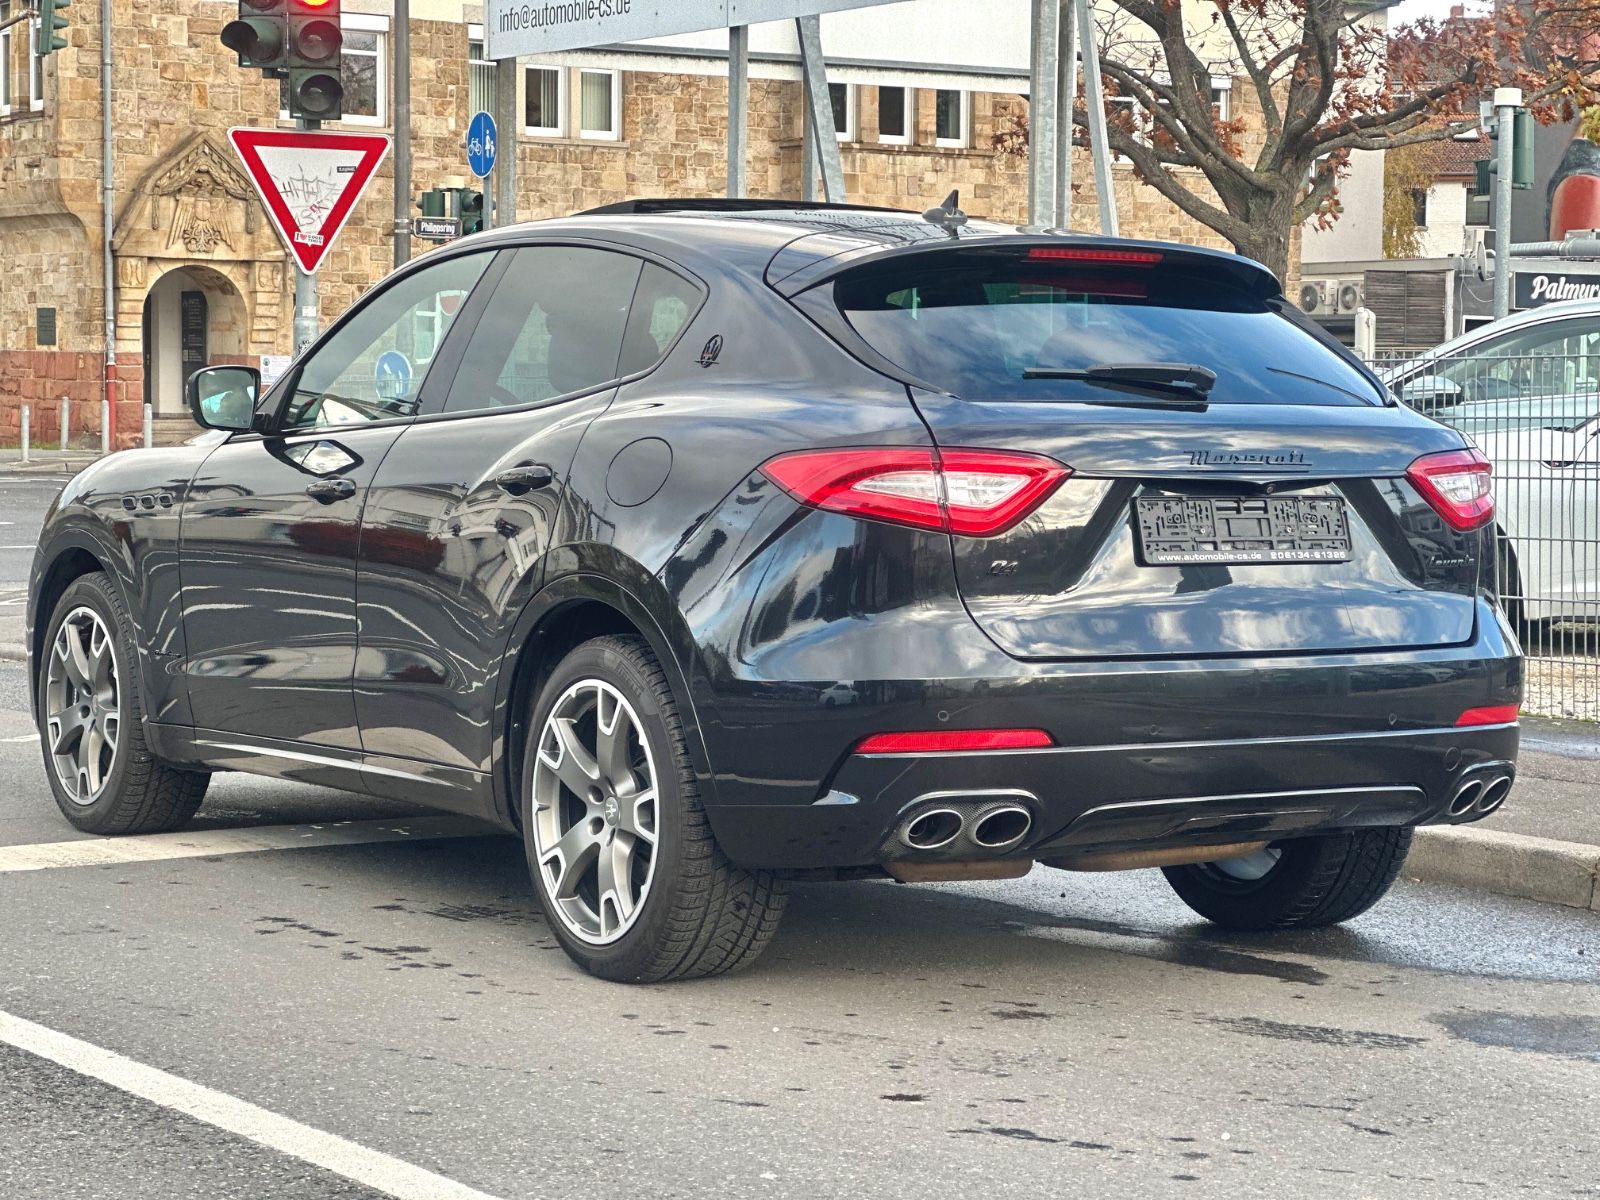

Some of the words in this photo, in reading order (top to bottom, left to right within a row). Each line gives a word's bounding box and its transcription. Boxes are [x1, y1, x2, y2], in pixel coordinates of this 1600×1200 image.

[499, 0, 631, 33] info@automobile-cs.de
[421, 221, 455, 234] Philippsring
[1530, 275, 1600, 300] Palmur
[1183, 450, 1313, 466] Maserati
[1157, 552, 1262, 561] www.automobile-cs.de
